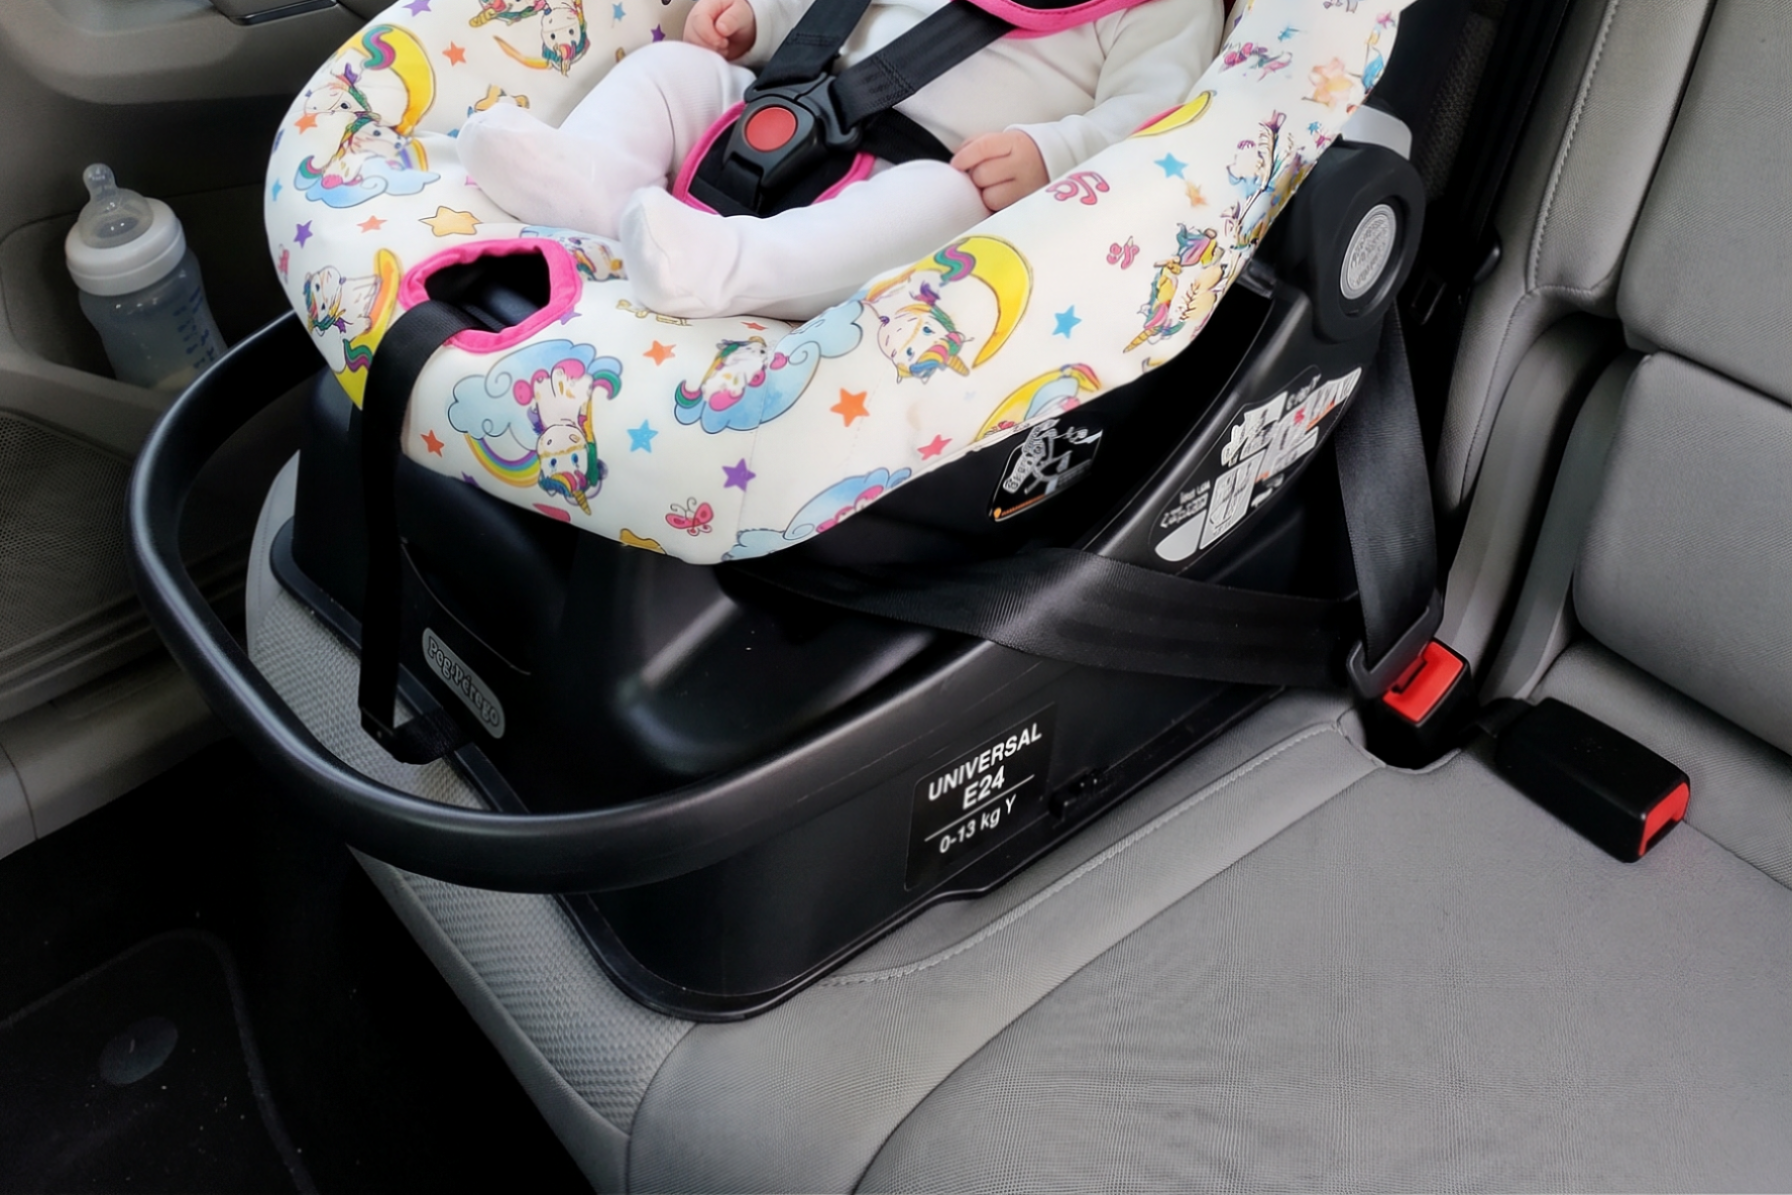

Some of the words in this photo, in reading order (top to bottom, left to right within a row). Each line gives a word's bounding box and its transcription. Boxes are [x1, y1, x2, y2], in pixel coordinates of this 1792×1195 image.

[928, 722, 1043, 802] UNIVERSAL
[962, 765, 1006, 811] E24
[938, 819, 977, 854] 0-13
[980, 807, 1001, 830] kg
[1005, 793, 1017, 815] Y
